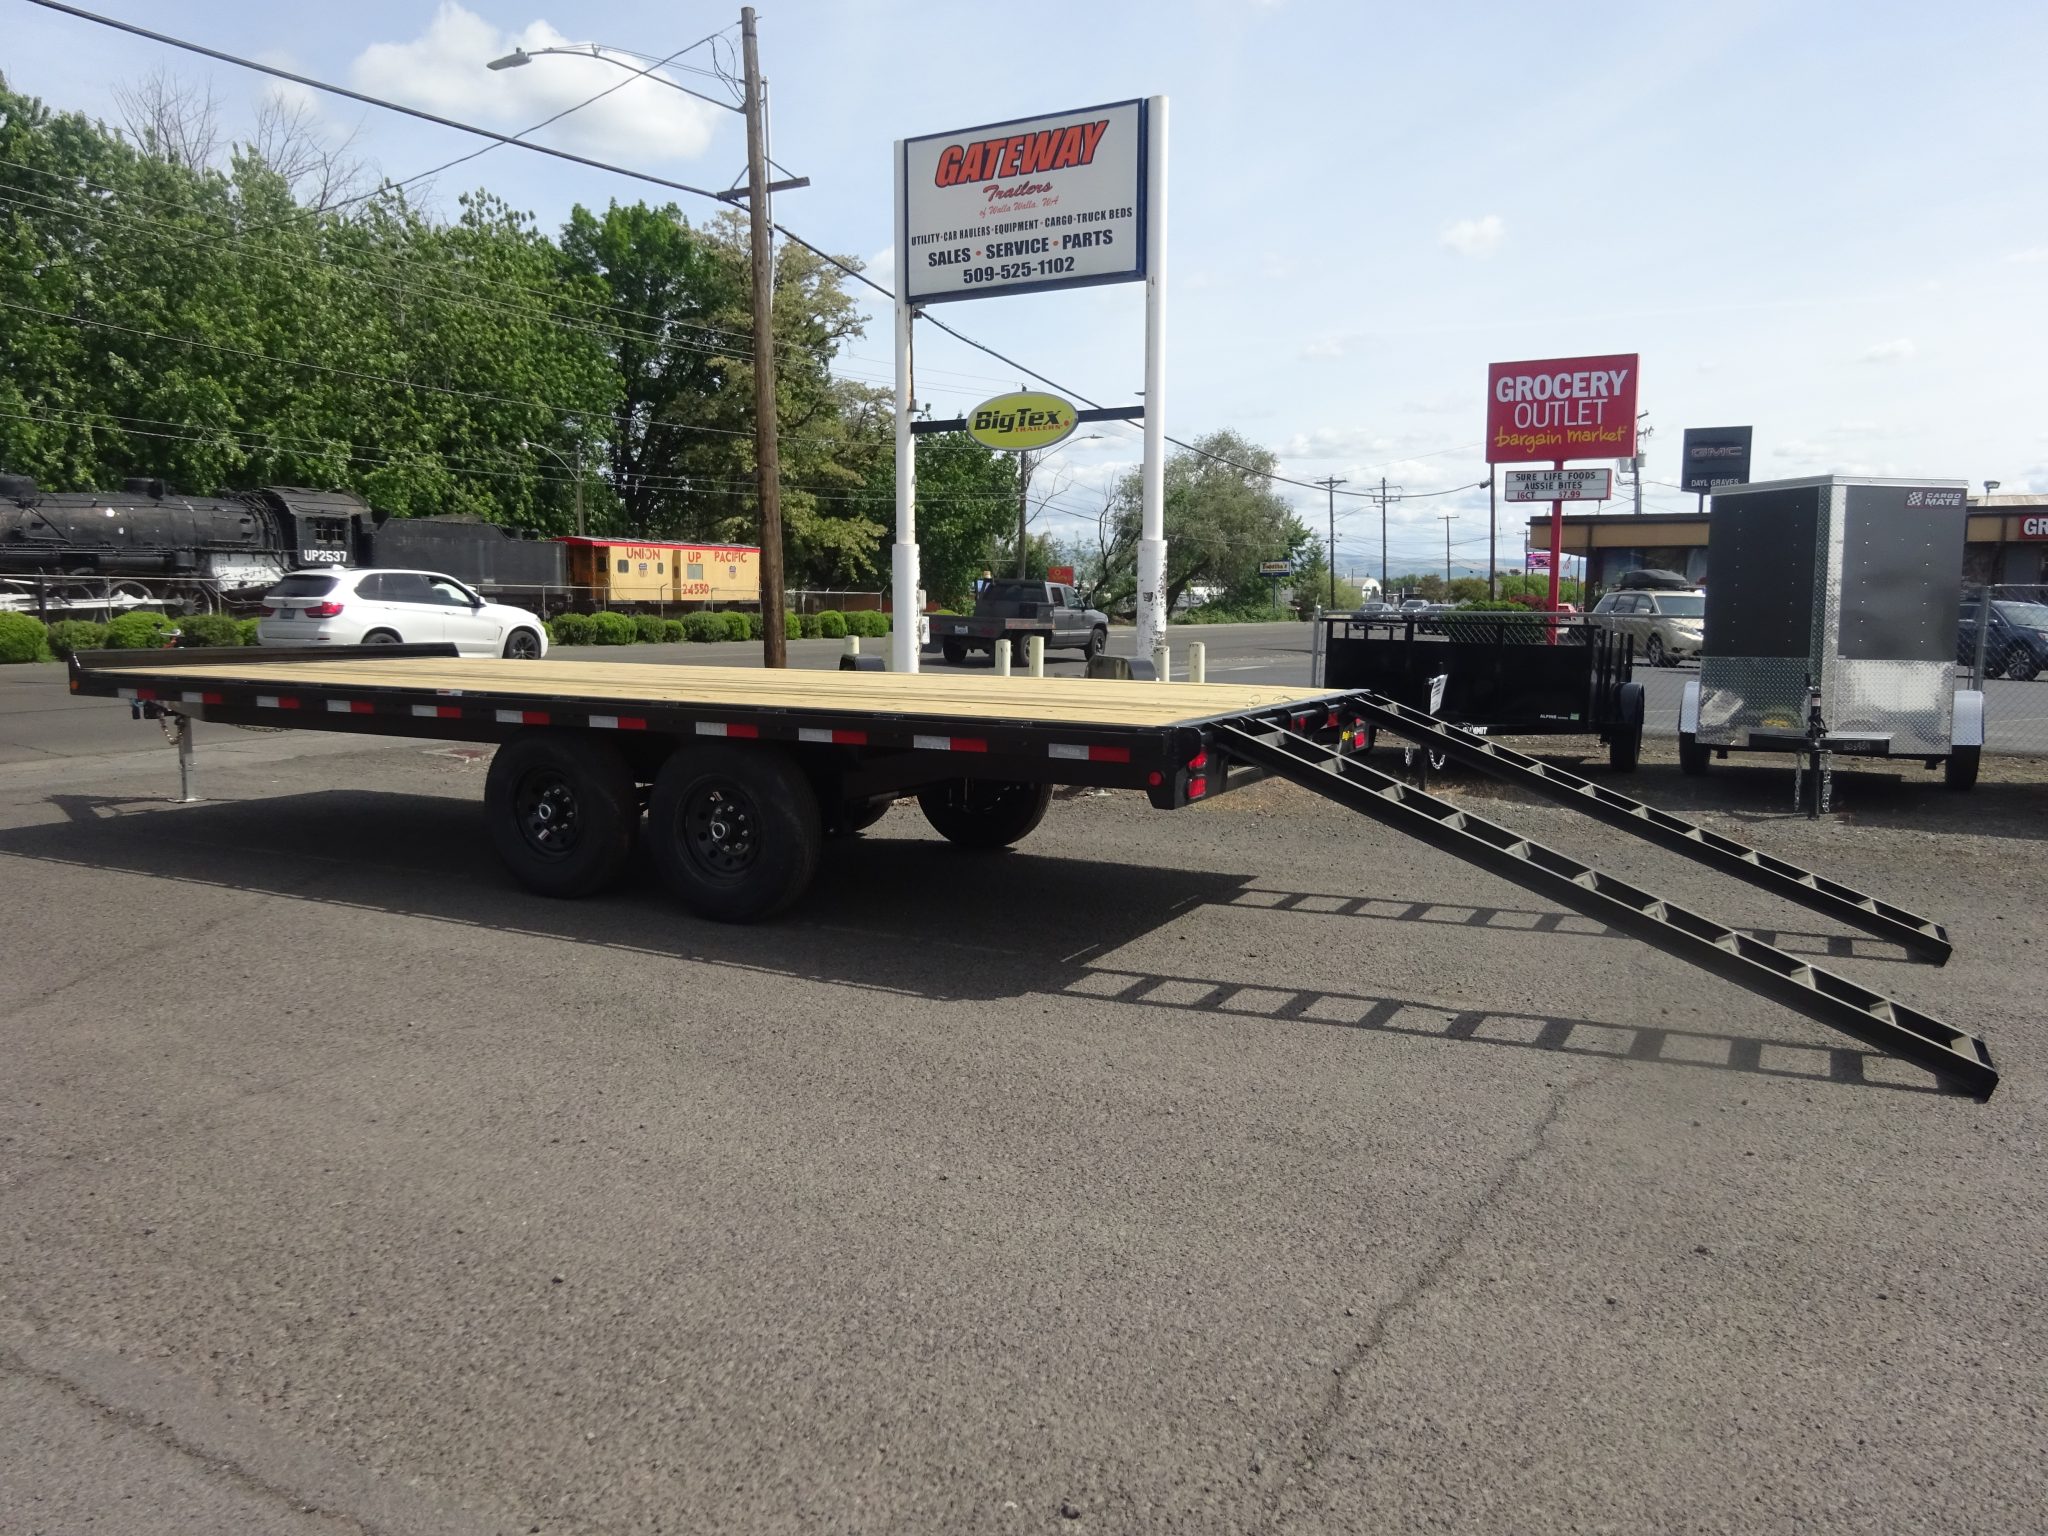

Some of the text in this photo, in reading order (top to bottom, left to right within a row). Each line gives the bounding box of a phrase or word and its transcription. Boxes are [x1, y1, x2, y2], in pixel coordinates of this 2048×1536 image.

[935, 119, 1110, 188] GATEWAY
[983, 181, 1053, 202] Trailers
[979, 207, 988, 219] of
[988, 205, 1011, 215] Walla
[1042, 196, 1059, 207] WA
[911, 207, 1133, 246] UTILITY CAR HAULERS EQUIPMENT CARGO TRUCK BEDS
[928, 229, 1113, 267] SALES SERVICE PARTS
[963, 256, 1075, 284] 509-525-1102
[1496, 369, 1628, 403] GROCERY
[1514, 399, 1609, 429] OUTLET
[1015, 424, 1061, 433] TRAILERS
[1494, 426, 1626, 454] bargain market
[1691, 446, 1743, 458] GMC
[1515, 472, 1596, 481] SURE LIFE FOODS
[1691, 478, 1739, 487] DAYL GRAVES
[1524, 481, 1583, 490] AUSSIE BITES
[1517, 490, 1581, 499] 16CT $7.99
[1925, 498, 1960, 506] MATE
[304, 549, 347, 562] UP2537
[626, 547, 660, 560] UNION
[687, 551, 748, 563] UP PACIFIC
[682, 583, 710, 595] 24550
